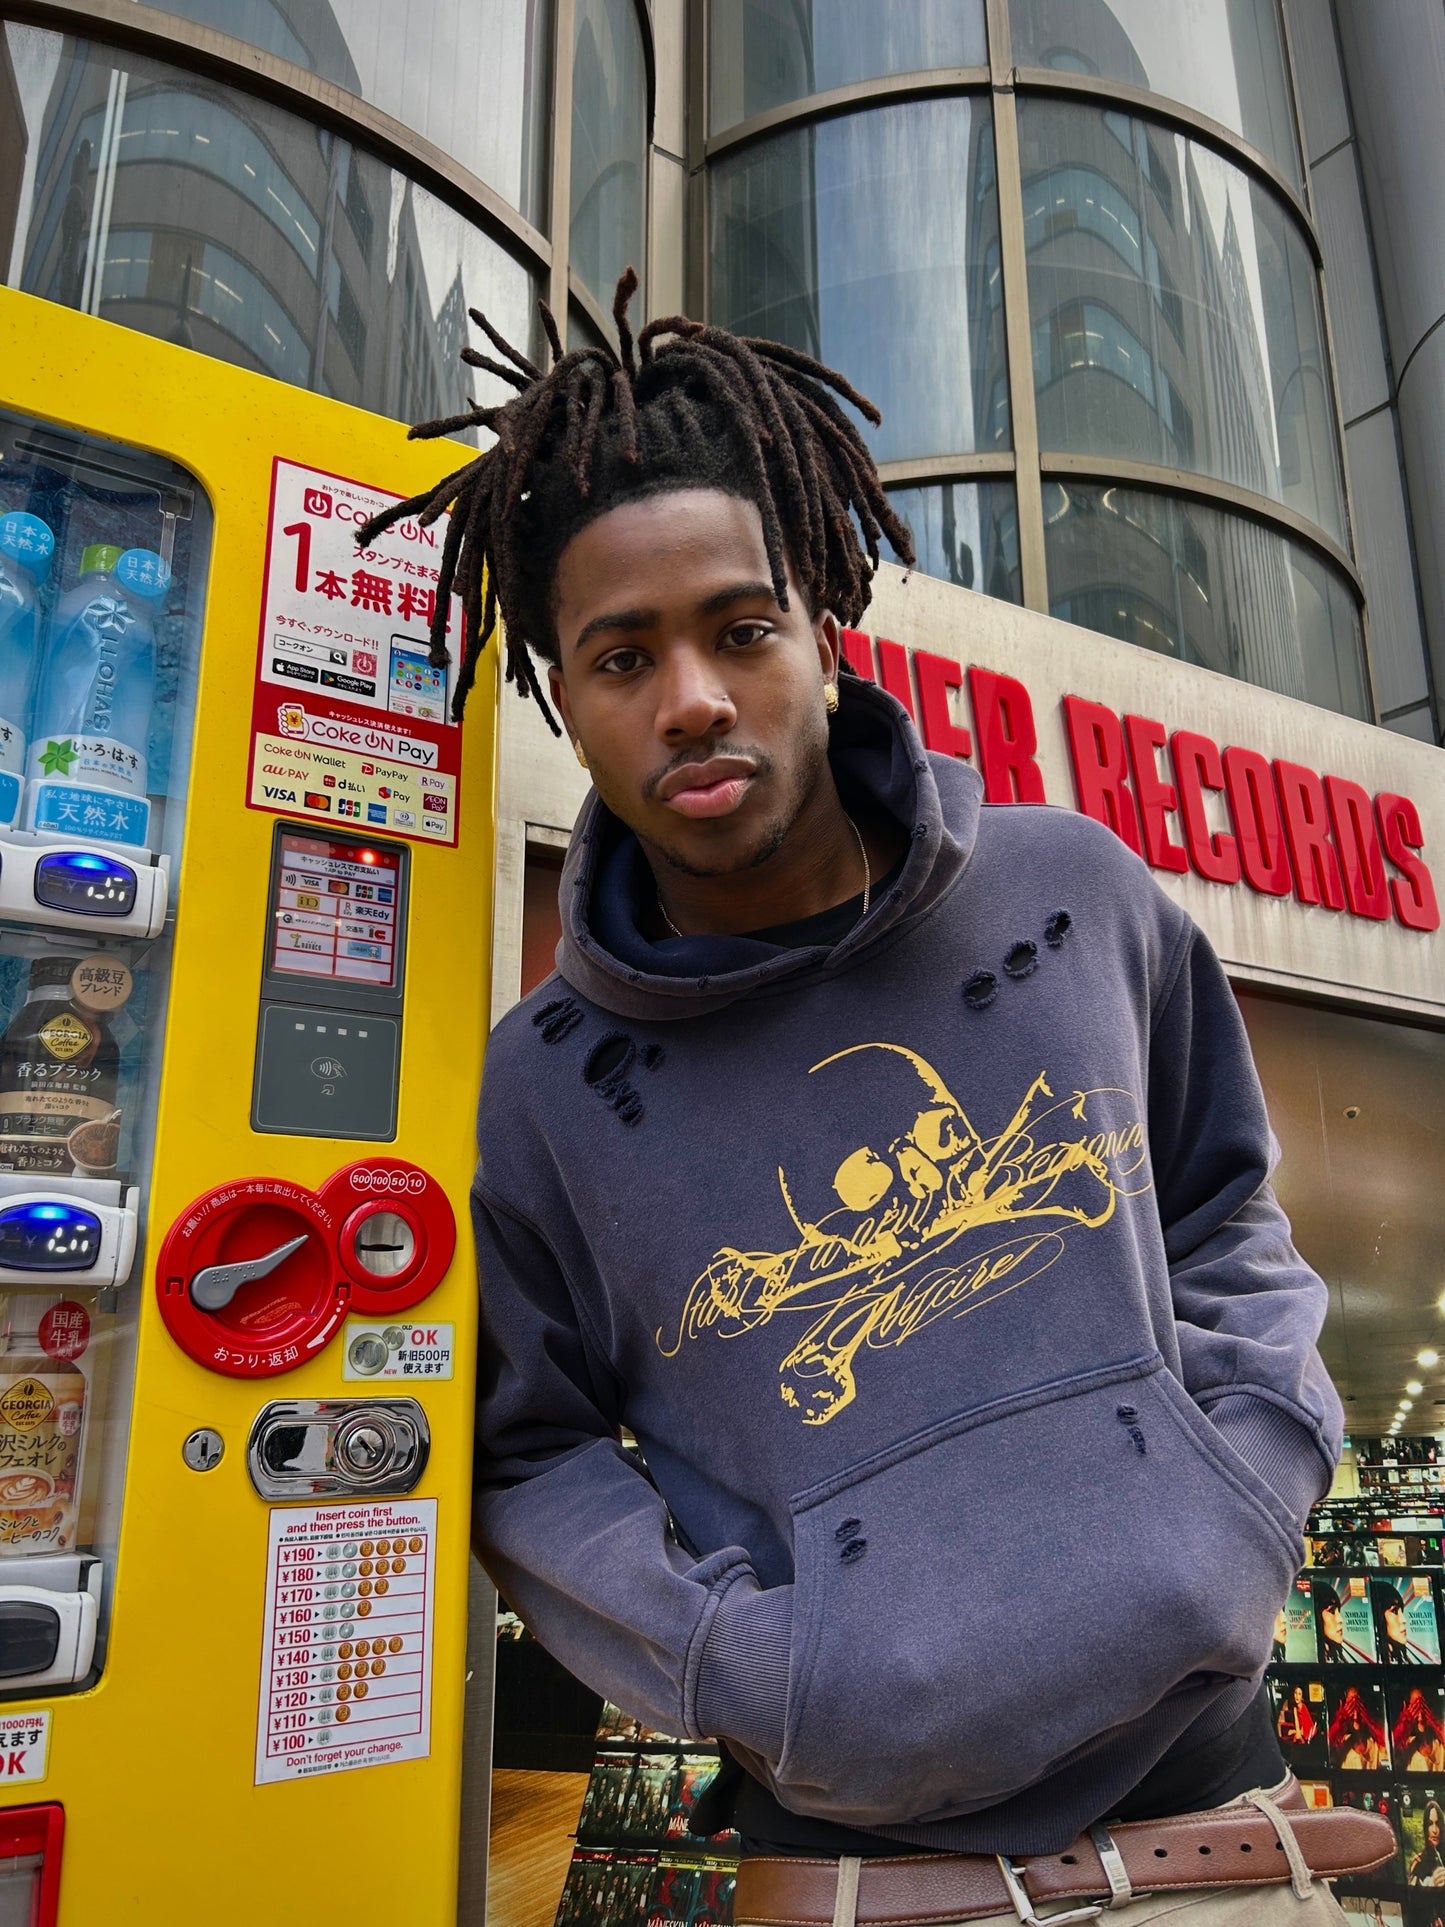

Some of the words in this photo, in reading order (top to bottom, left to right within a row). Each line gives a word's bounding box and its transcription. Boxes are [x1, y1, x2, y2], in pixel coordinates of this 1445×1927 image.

[5, 521, 51, 542] 日本の
[3, 535, 49, 555] 天然水
[126, 569, 167, 588] 天然水
[279, 639, 314, 653] コークオン
[287, 664, 300, 673] App
[337, 675, 360, 687] Google
[360, 681, 373, 691] Play
[311, 720, 361, 745] Coke
[365, 731, 394, 753] ON
[398, 740, 435, 764] Pay
[264, 743, 293, 757] Coke
[294, 749, 312, 761] ON
[313, 753, 347, 769] Wallet
[262, 764, 288, 776] au
[288, 768, 309, 780] PAY
[375, 766, 408, 782] PayPay
[338, 779, 366, 793] d払い
[430, 778, 445, 790] Pay
[44, 789, 144, 813] 私と地球にやさしい
[262, 785, 297, 803] VISA
[393, 790, 411, 803] Pay
[57, 802, 129, 830] 天然水
[1063, 694, 1441, 931] RECORDS
[431, 821, 444, 831] Pay
[303, 878, 320, 888] VISA
[355, 905, 390, 920] 楽天Edy
[80, 967, 126, 986] 高級豆
[81, 984, 122, 997] ブレンド
[51, 1037, 80, 1047] Coffee
[16, 1061, 102, 1082] 香るブラック
[17, 1156, 63, 1169] 香りとコク
[352, 1174, 371, 1186] 500
[372, 1175, 390, 1187] 100
[52, 1310, 84, 1329] 国産
[50, 1329, 82, 1348] 牛乳
[411, 1329, 439, 1346] OK
[213, 1345, 299, 1369] おつり・返却
[403, 1362, 444, 1374] 使えます
[1, 1400, 51, 1410] GEORGIA
[11, 1410, 41, 1421] Coffee
[315, 1510, 346, 1521] Insert
[348, 1508, 371, 1519] coin
[373, 1506, 393, 1517] first
[286, 1522, 307, 1534] and
[310, 1520, 333, 1532] then
[336, 1519, 365, 1533] press
[367, 1517, 384, 1528] the
[386, 1515, 421, 1526] button.
[283, 1547, 315, 1562] ¥190
[282, 1567, 314, 1583] ¥180
[281, 1588, 313, 1603] ¥170
[280, 1608, 312, 1624] ¥160
[279, 1628, 311, 1645] ¥150
[277, 1649, 310, 1666] ¥140
[276, 1670, 309, 1687] ¥130
[275, 1691, 308, 1709] ¥120
[274, 1712, 307, 1730] ¥110
[272, 1734, 306, 1752] ¥100
[286, 1755, 312, 1767] Don't
[314, 1750, 342, 1763] forget
[344, 1747, 366, 1761] your
[367, 1741, 403, 1754] change.
